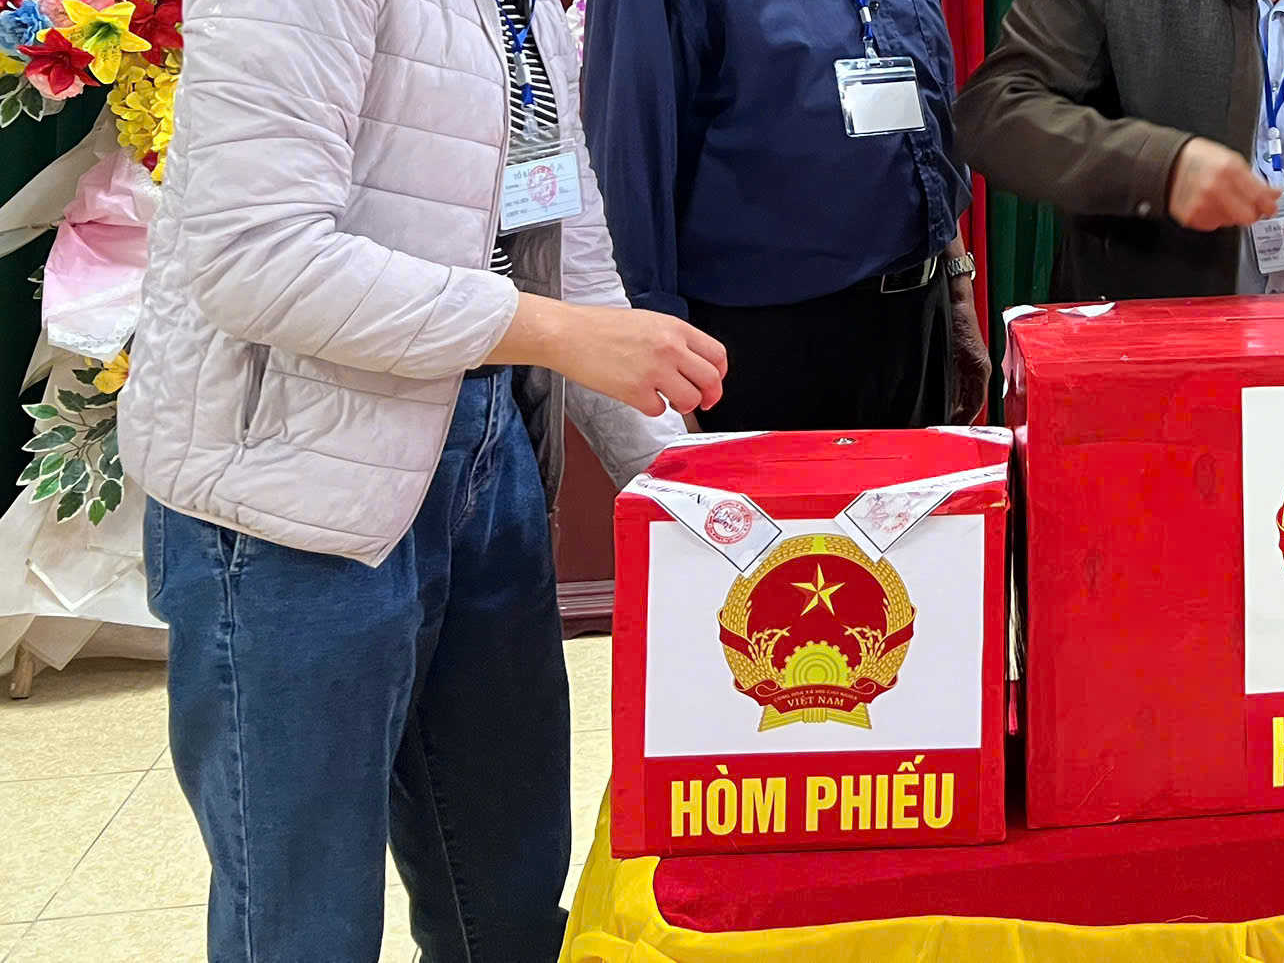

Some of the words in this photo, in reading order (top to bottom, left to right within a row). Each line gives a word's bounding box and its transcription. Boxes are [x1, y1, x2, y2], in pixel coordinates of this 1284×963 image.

[817, 696, 844, 706] NAM
[671, 764, 786, 837] HÒM
[805, 755, 954, 832] PHIẾU
